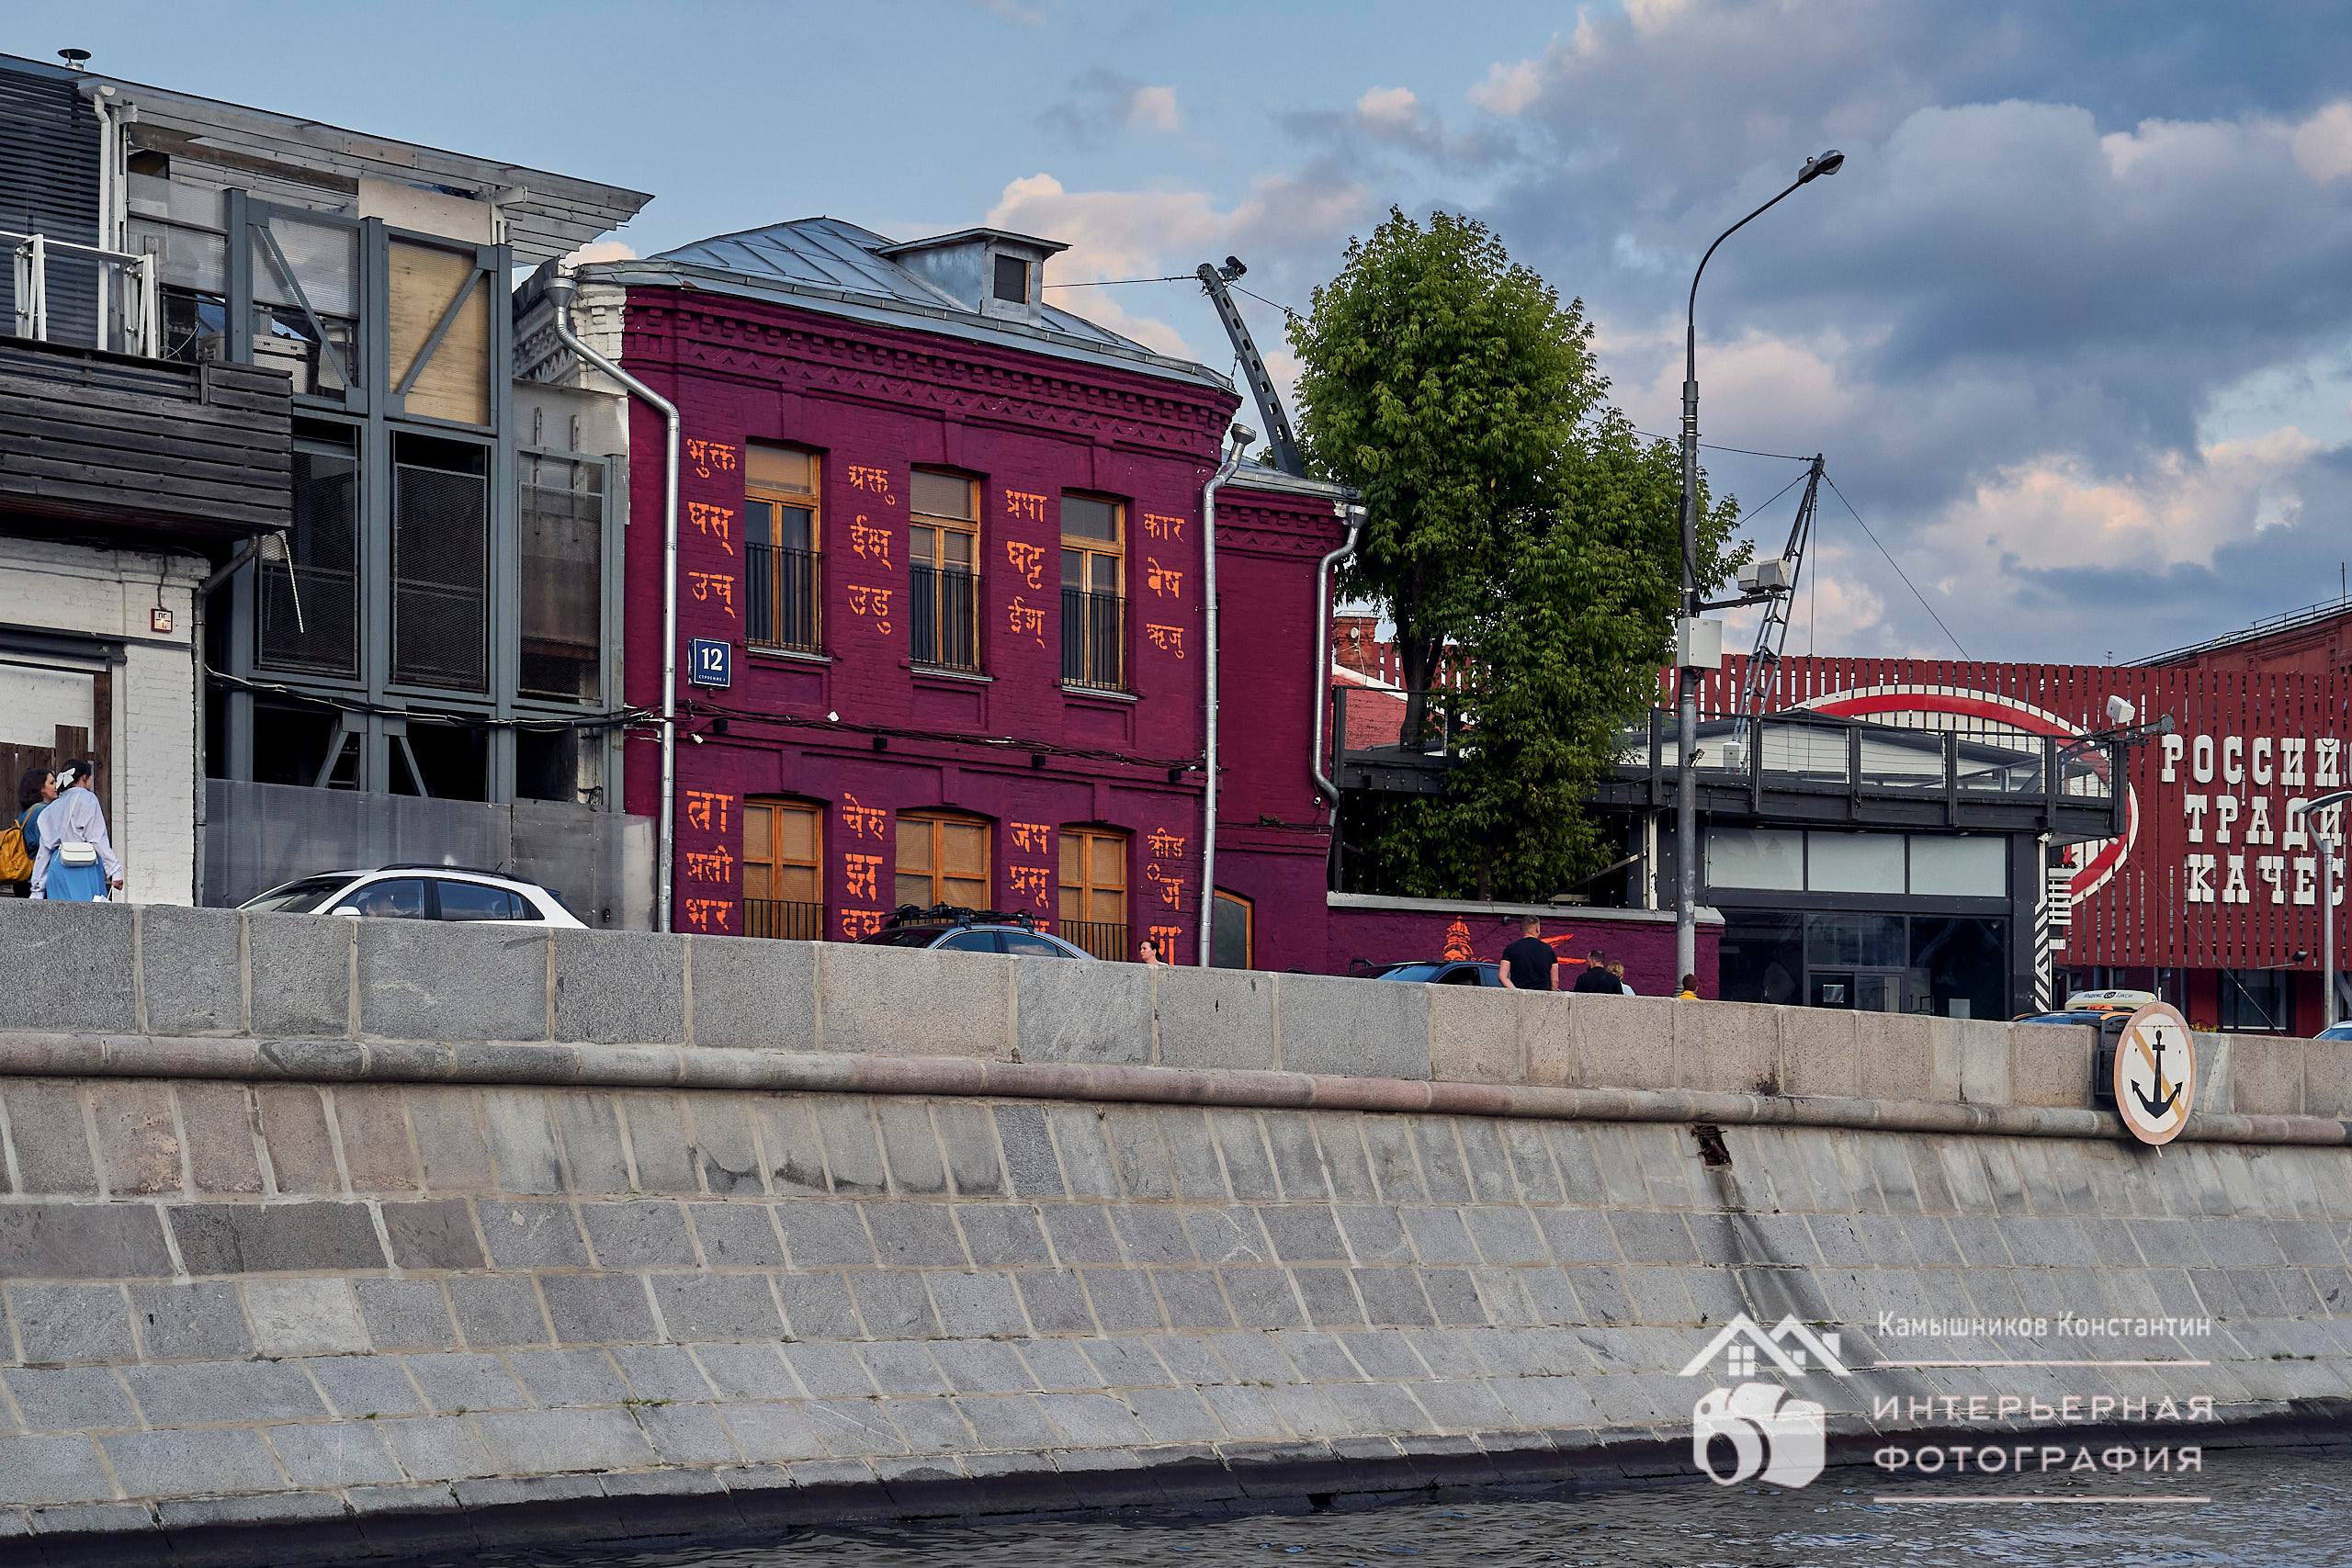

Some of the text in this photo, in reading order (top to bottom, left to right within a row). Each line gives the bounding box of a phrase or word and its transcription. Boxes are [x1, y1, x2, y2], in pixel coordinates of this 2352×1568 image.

[701, 647, 723, 671] 12
[2161, 734, 2352, 787] РОССИЙ
[2186, 794, 2352, 852] ТРАДИ
